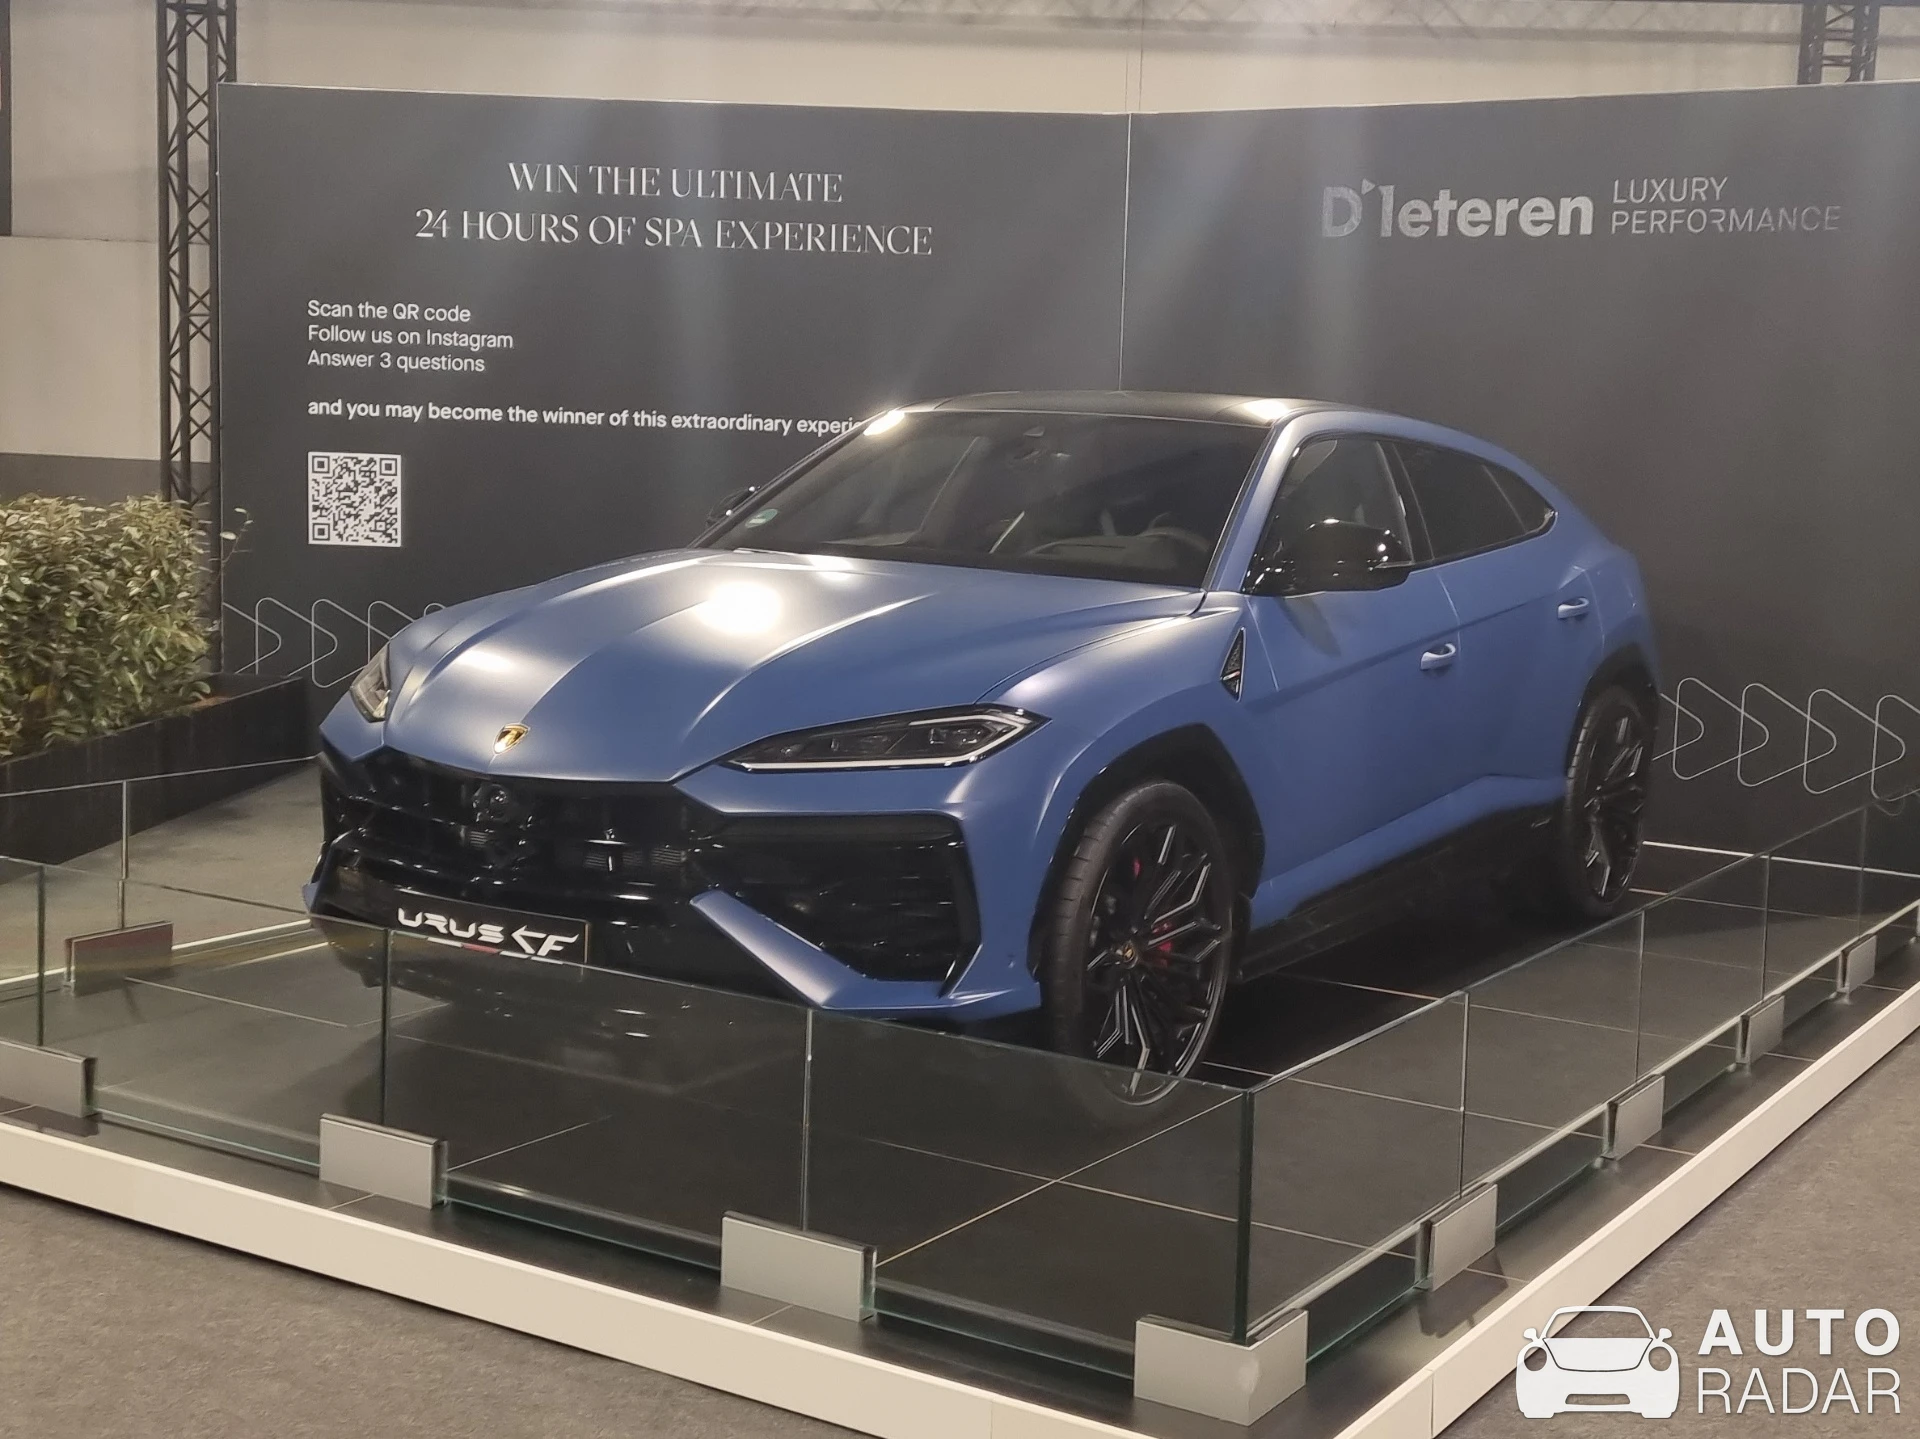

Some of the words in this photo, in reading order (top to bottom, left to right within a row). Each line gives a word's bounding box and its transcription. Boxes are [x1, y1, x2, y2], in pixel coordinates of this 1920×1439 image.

[508, 163, 579, 194] WIN
[589, 165, 661, 196] THE
[671, 168, 842, 203] ULTIMATE
[1613, 176, 1728, 204] LUXURY
[415, 208, 450, 238] 24
[461, 210, 579, 243] HOURS
[588, 215, 637, 245] OF
[644, 217, 703, 248] SPA
[716, 219, 932, 255] EXPERIENCE
[1611, 205, 1842, 235] PERFORMANCE
[307, 300, 353, 318] Scan
[358, 301, 388, 320] the
[393, 302, 420, 321] QR
[424, 304, 471, 322] code
[308, 325, 366, 343] Follow
[371, 331, 393, 344] us
[397, 331, 421, 345] on
[426, 329, 514, 351] Instagram
[307, 350, 375, 368] Answer
[380, 352, 391, 369] 3
[396, 354, 486, 373] questions
[307, 399, 342, 416] and
[346, 402, 380, 420] you
[385, 404, 423, 423] may
[428, 402, 503, 422] become
[507, 405, 538, 424] the
[541, 406, 605, 425] winner
[609, 409, 629, 427] of
[633, 410, 667, 428] this
[671, 413, 793, 436] extraordinary
[398, 907, 505, 944] URUS
